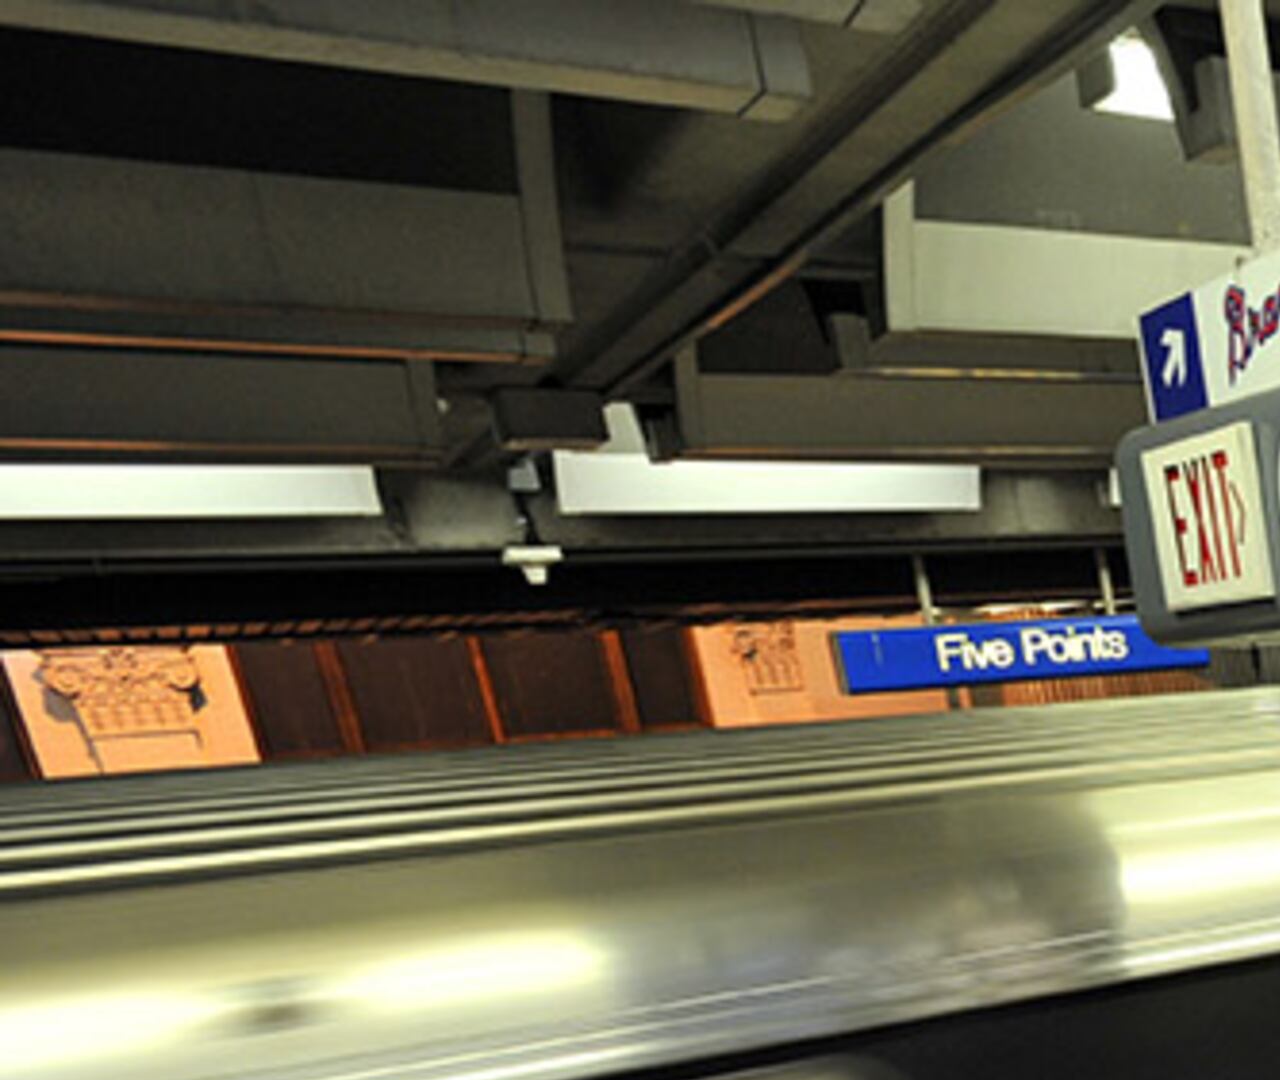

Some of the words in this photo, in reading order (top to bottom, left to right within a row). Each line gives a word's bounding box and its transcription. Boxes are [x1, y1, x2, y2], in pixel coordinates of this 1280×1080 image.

[1163, 450, 1242, 586] EXIT
[934, 633, 1015, 672] Five
[1019, 625, 1129, 665] Points
